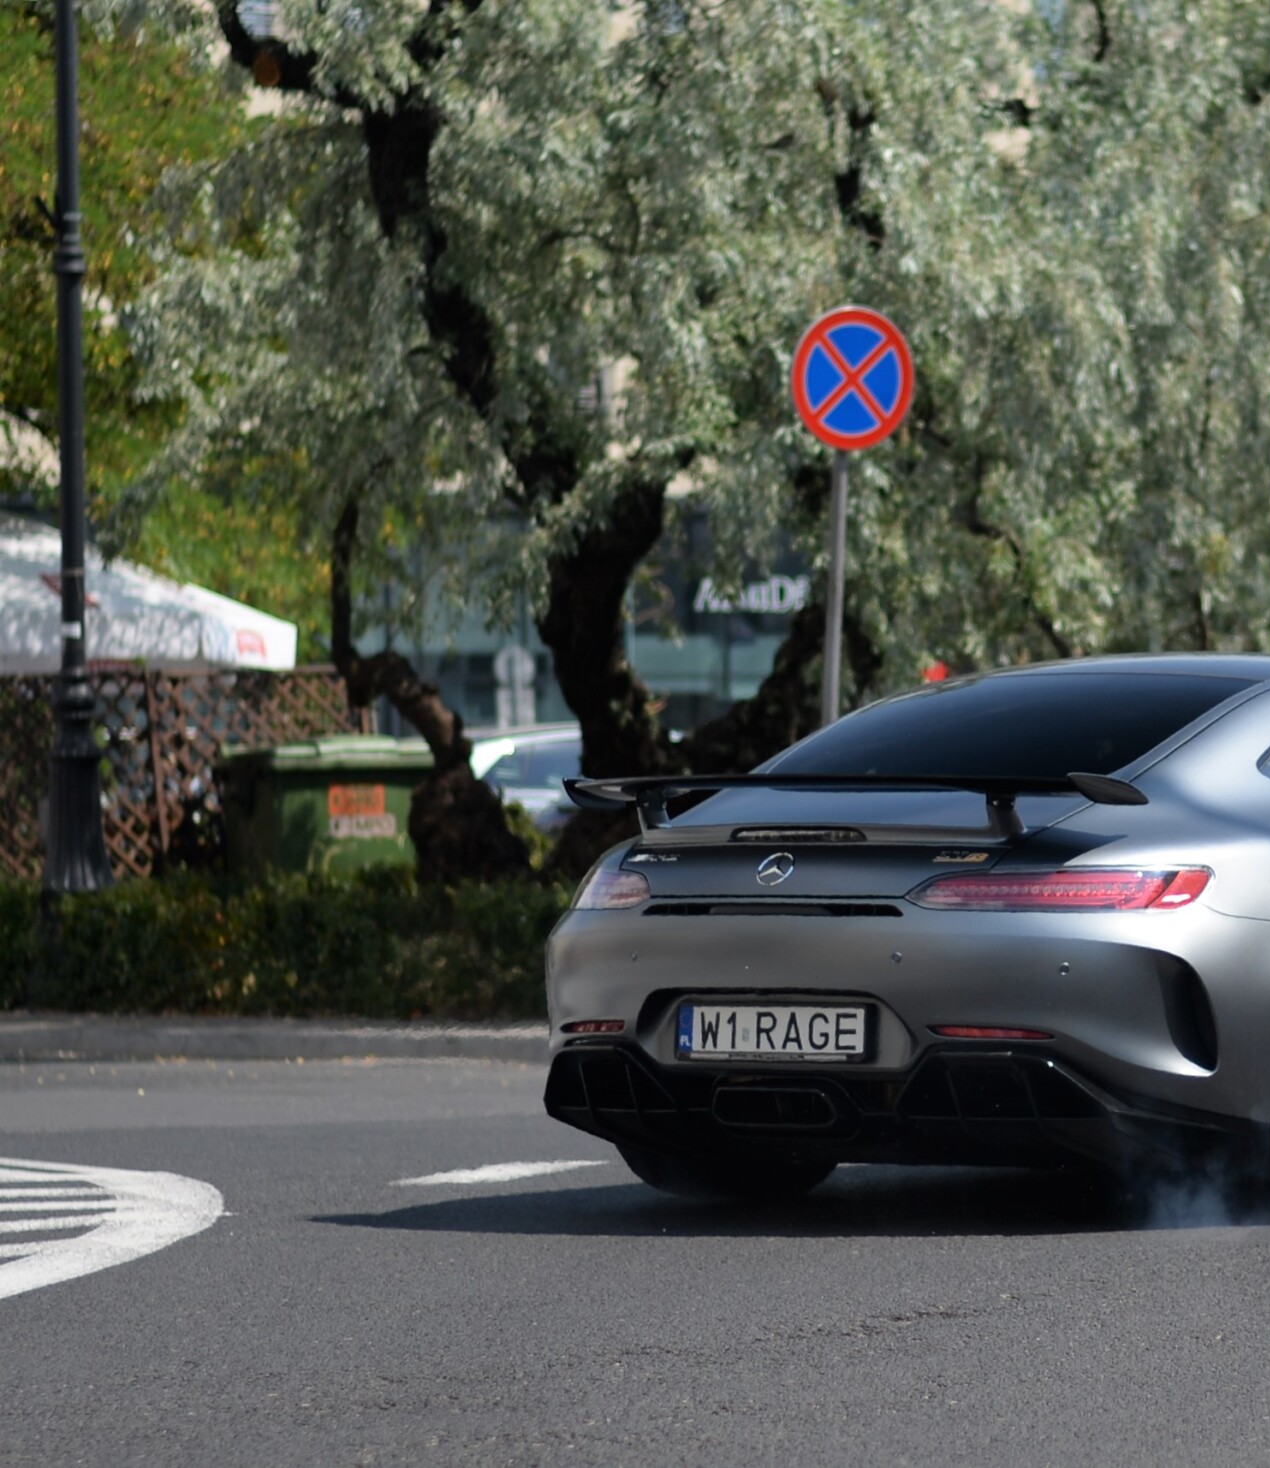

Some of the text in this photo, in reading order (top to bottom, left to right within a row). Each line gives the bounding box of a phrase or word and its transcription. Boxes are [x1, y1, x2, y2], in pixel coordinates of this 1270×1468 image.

[680, 1035, 691, 1046] PL
[701, 1011, 858, 1051] W1 RAGE
